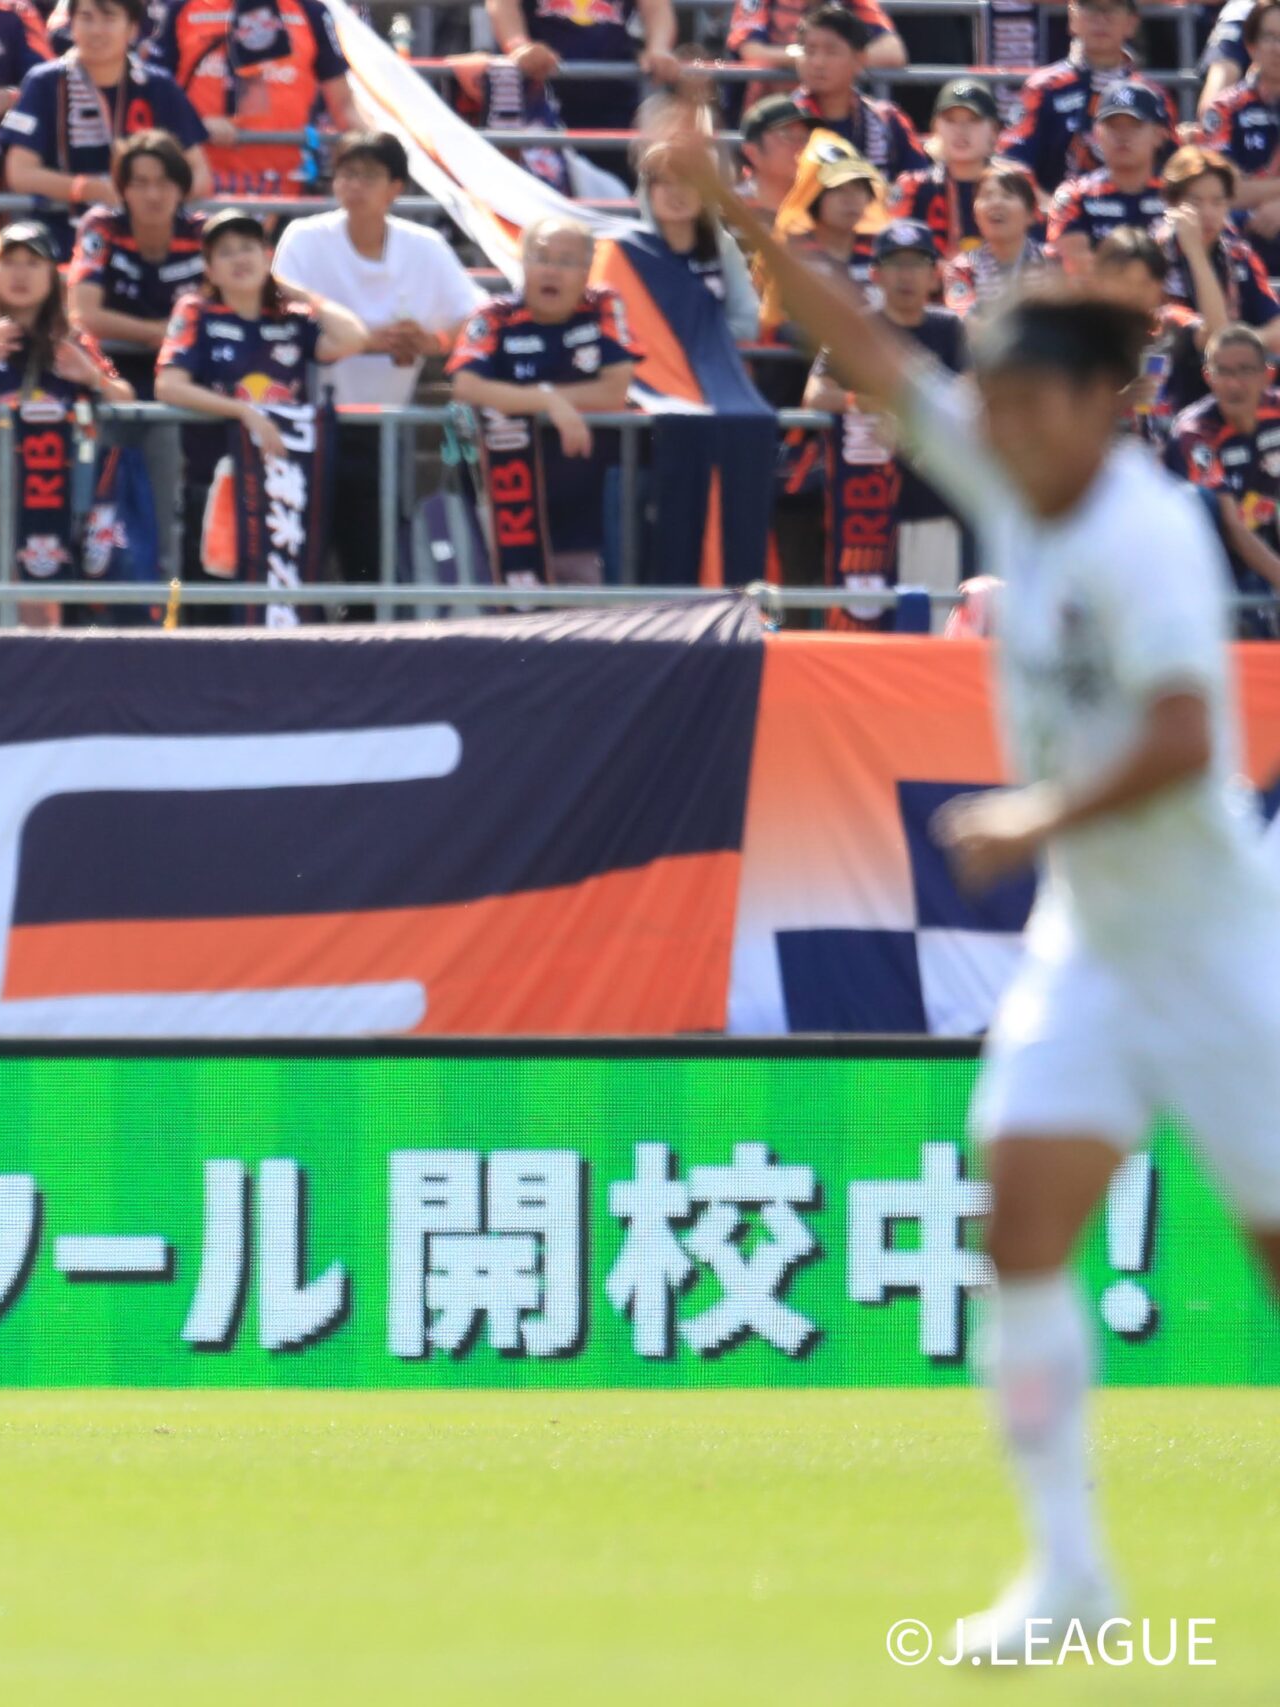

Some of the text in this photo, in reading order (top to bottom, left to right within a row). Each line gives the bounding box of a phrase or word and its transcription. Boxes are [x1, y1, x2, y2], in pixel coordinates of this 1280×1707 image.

[22, 430, 65, 510] RB
[490, 458, 537, 547] RB
[842, 472, 892, 546] RB
